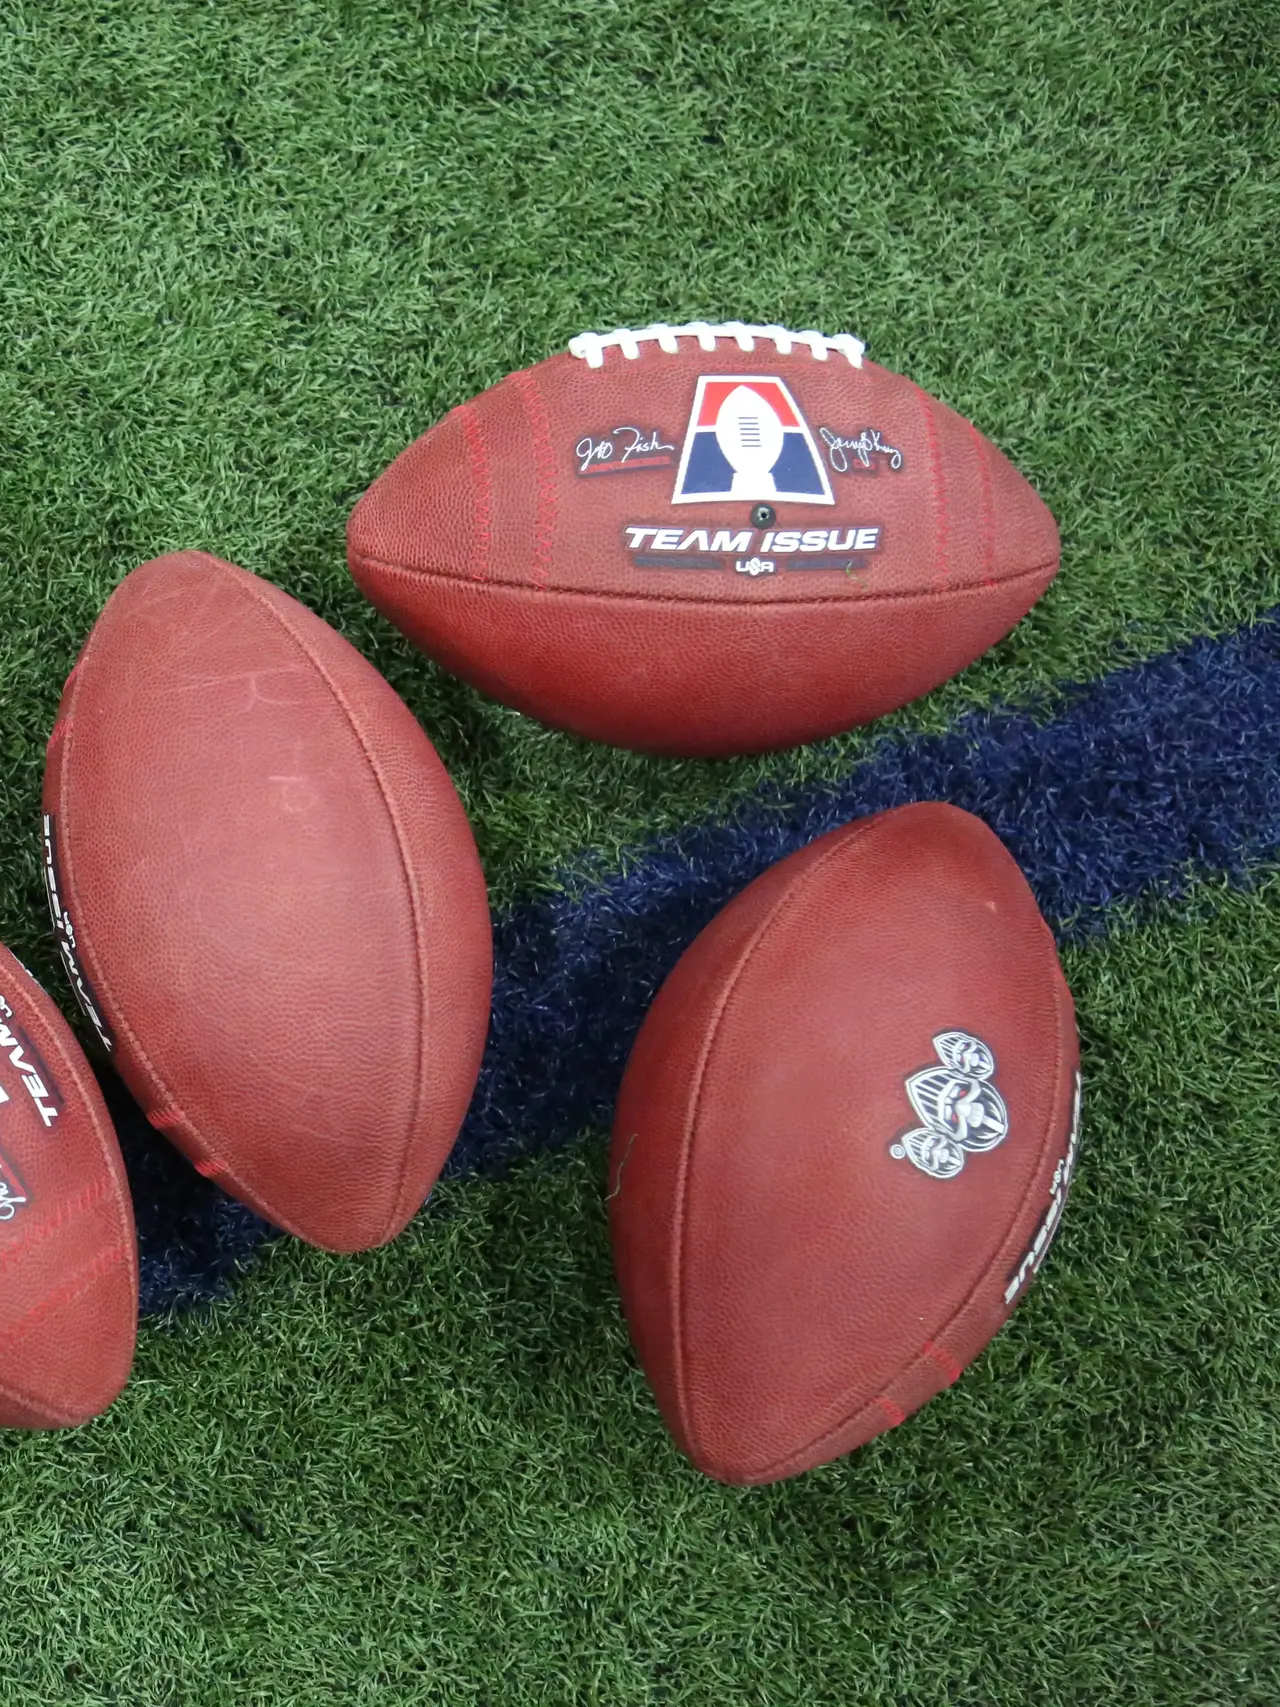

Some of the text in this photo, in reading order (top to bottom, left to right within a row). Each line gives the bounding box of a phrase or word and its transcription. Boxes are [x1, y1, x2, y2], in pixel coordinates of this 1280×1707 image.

[625, 527, 880, 553] TEAM ISSUE
[735, 556, 774, 575] USA
